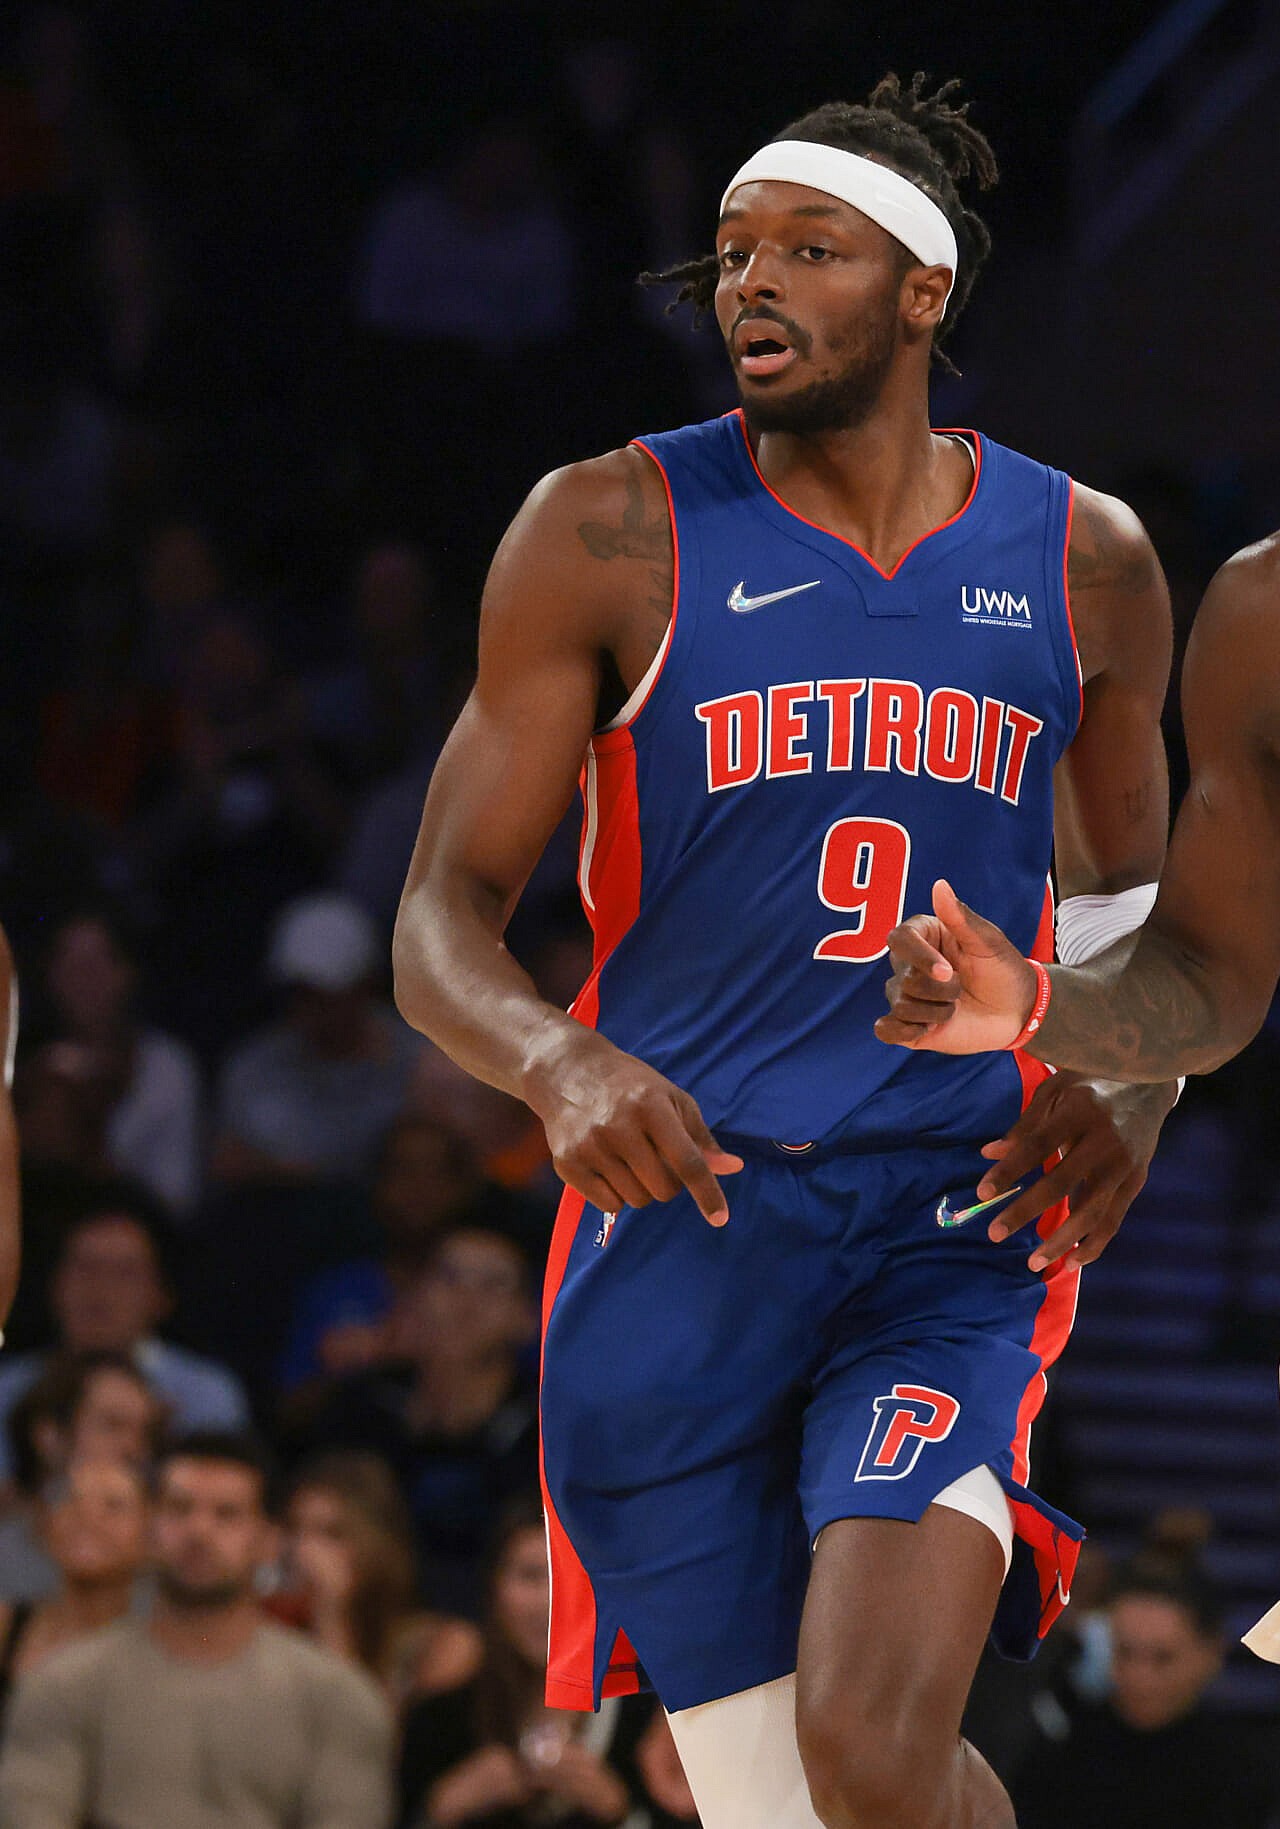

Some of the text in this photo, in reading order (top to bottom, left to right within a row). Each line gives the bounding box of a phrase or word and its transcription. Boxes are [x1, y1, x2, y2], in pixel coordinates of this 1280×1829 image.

[961, 585, 1031, 619] UWM
[694, 677, 1044, 807] DETROIT
[812, 816, 911, 964] 9
